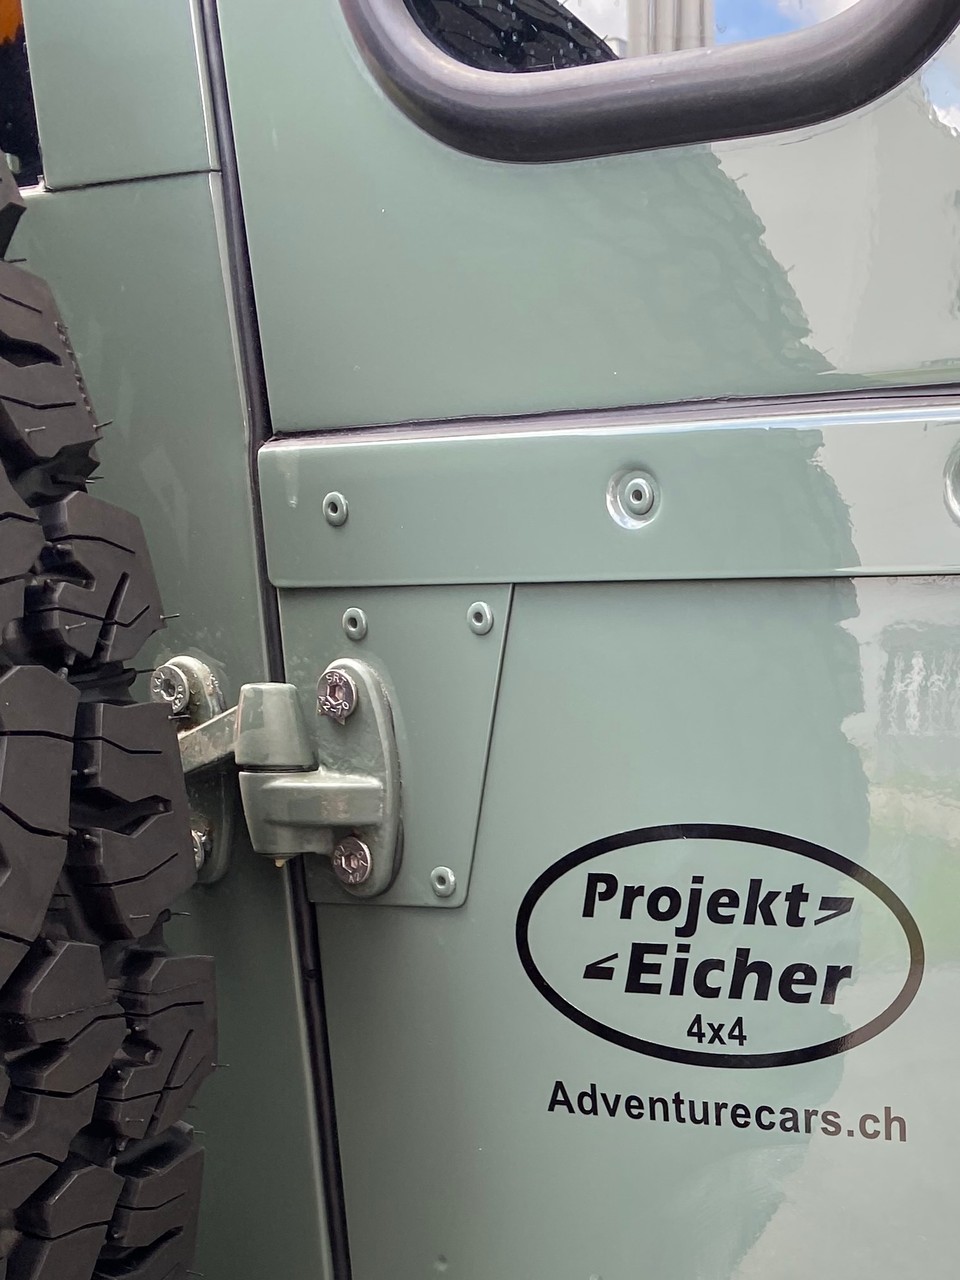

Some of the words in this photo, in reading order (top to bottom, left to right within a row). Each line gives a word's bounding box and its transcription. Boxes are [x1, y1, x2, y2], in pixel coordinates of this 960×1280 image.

[582, 872, 810, 939] Projekt
[624, 942, 853, 1005] Eicher
[686, 1013, 748, 1047] 4x4
[547, 1080, 907, 1142] Adventurecars.ch
